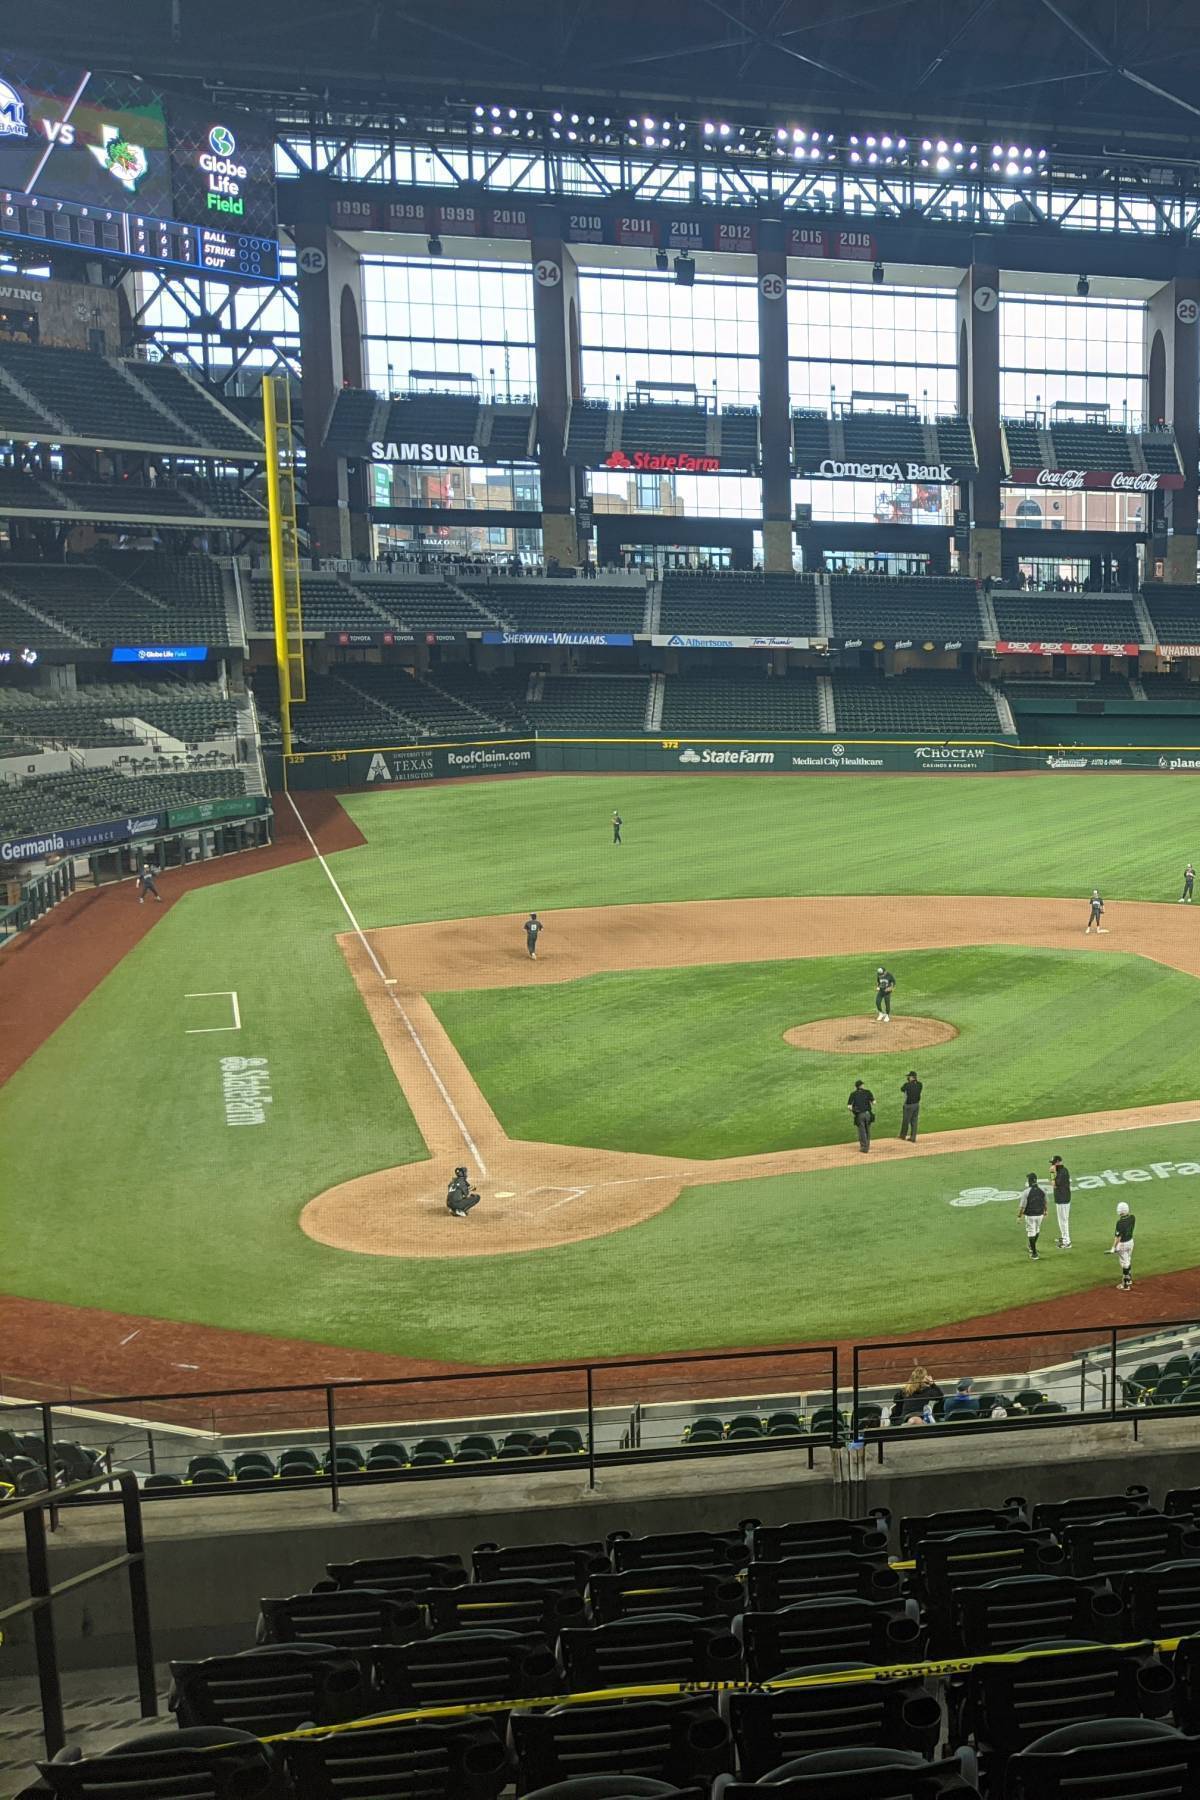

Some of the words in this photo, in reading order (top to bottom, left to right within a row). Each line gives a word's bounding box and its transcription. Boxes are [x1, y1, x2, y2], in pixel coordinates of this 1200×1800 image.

[42, 118, 75, 145] VS
[199, 154, 248, 179] Globe
[209, 176, 239, 195] Life
[207, 192, 243, 215] Field
[337, 201, 371, 216] 1996
[389, 204, 425, 219] 1998
[440, 206, 475, 221] 1999
[493, 210, 526, 224] 2010
[570, 215, 602, 230] 2010
[621, 218, 651, 233] 2011
[671, 221, 700, 236] 2011
[203, 231, 227, 244] BALL
[719, 225, 751, 240] 2012
[792, 229, 822, 244] 2015
[840, 232, 870, 247] 2016
[204, 244, 236, 258] STRIKE
[205, 256, 226, 268] OUT
[302, 252, 321, 267] 42
[538, 266, 558, 281] 34
[763, 280, 782, 294] 26
[980, 292, 990, 306] 7
[1178, 304, 1197, 318] 29
[371, 442, 479, 462] SAMSUNG
[906, 463, 952, 480] Bank
[685, 638, 734, 647] Albertsons
[768, 638, 792, 646] Thumb
[1072, 643, 1094, 651] DEX
[662, 741, 678, 749] 372
[448, 750, 531, 764] RoofClaim.com
[921, 747, 985, 759] CHOCTAW
[393, 758, 433, 772] TEXAS
[792, 757, 823, 767] Medical
[824, 758, 840, 768] City
[841, 758, 883, 767] Healthcare
[1, 832, 64, 860] Germania
[66, 831, 114, 848] INSURANCE
